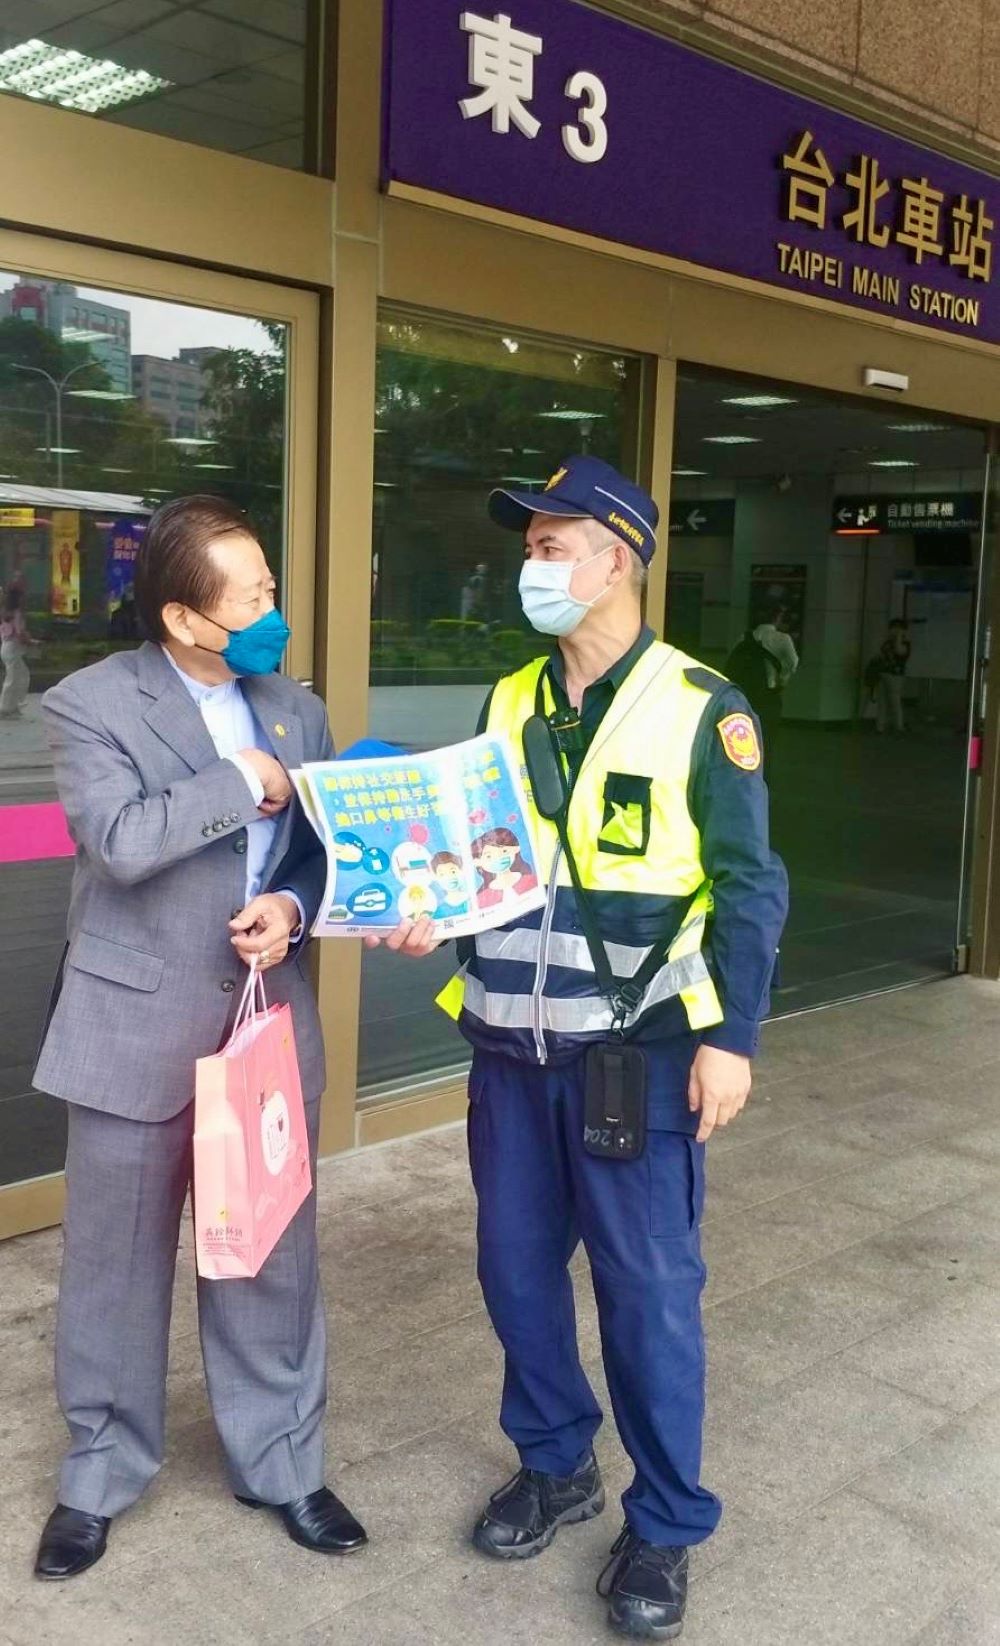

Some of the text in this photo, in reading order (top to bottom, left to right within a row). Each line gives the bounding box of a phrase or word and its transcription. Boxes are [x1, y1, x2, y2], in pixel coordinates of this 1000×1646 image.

[459, 11, 608, 163] 東 3
[782, 130, 995, 283] 台北車站
[777, 242, 980, 327] TAIPEI MAIN STATION
